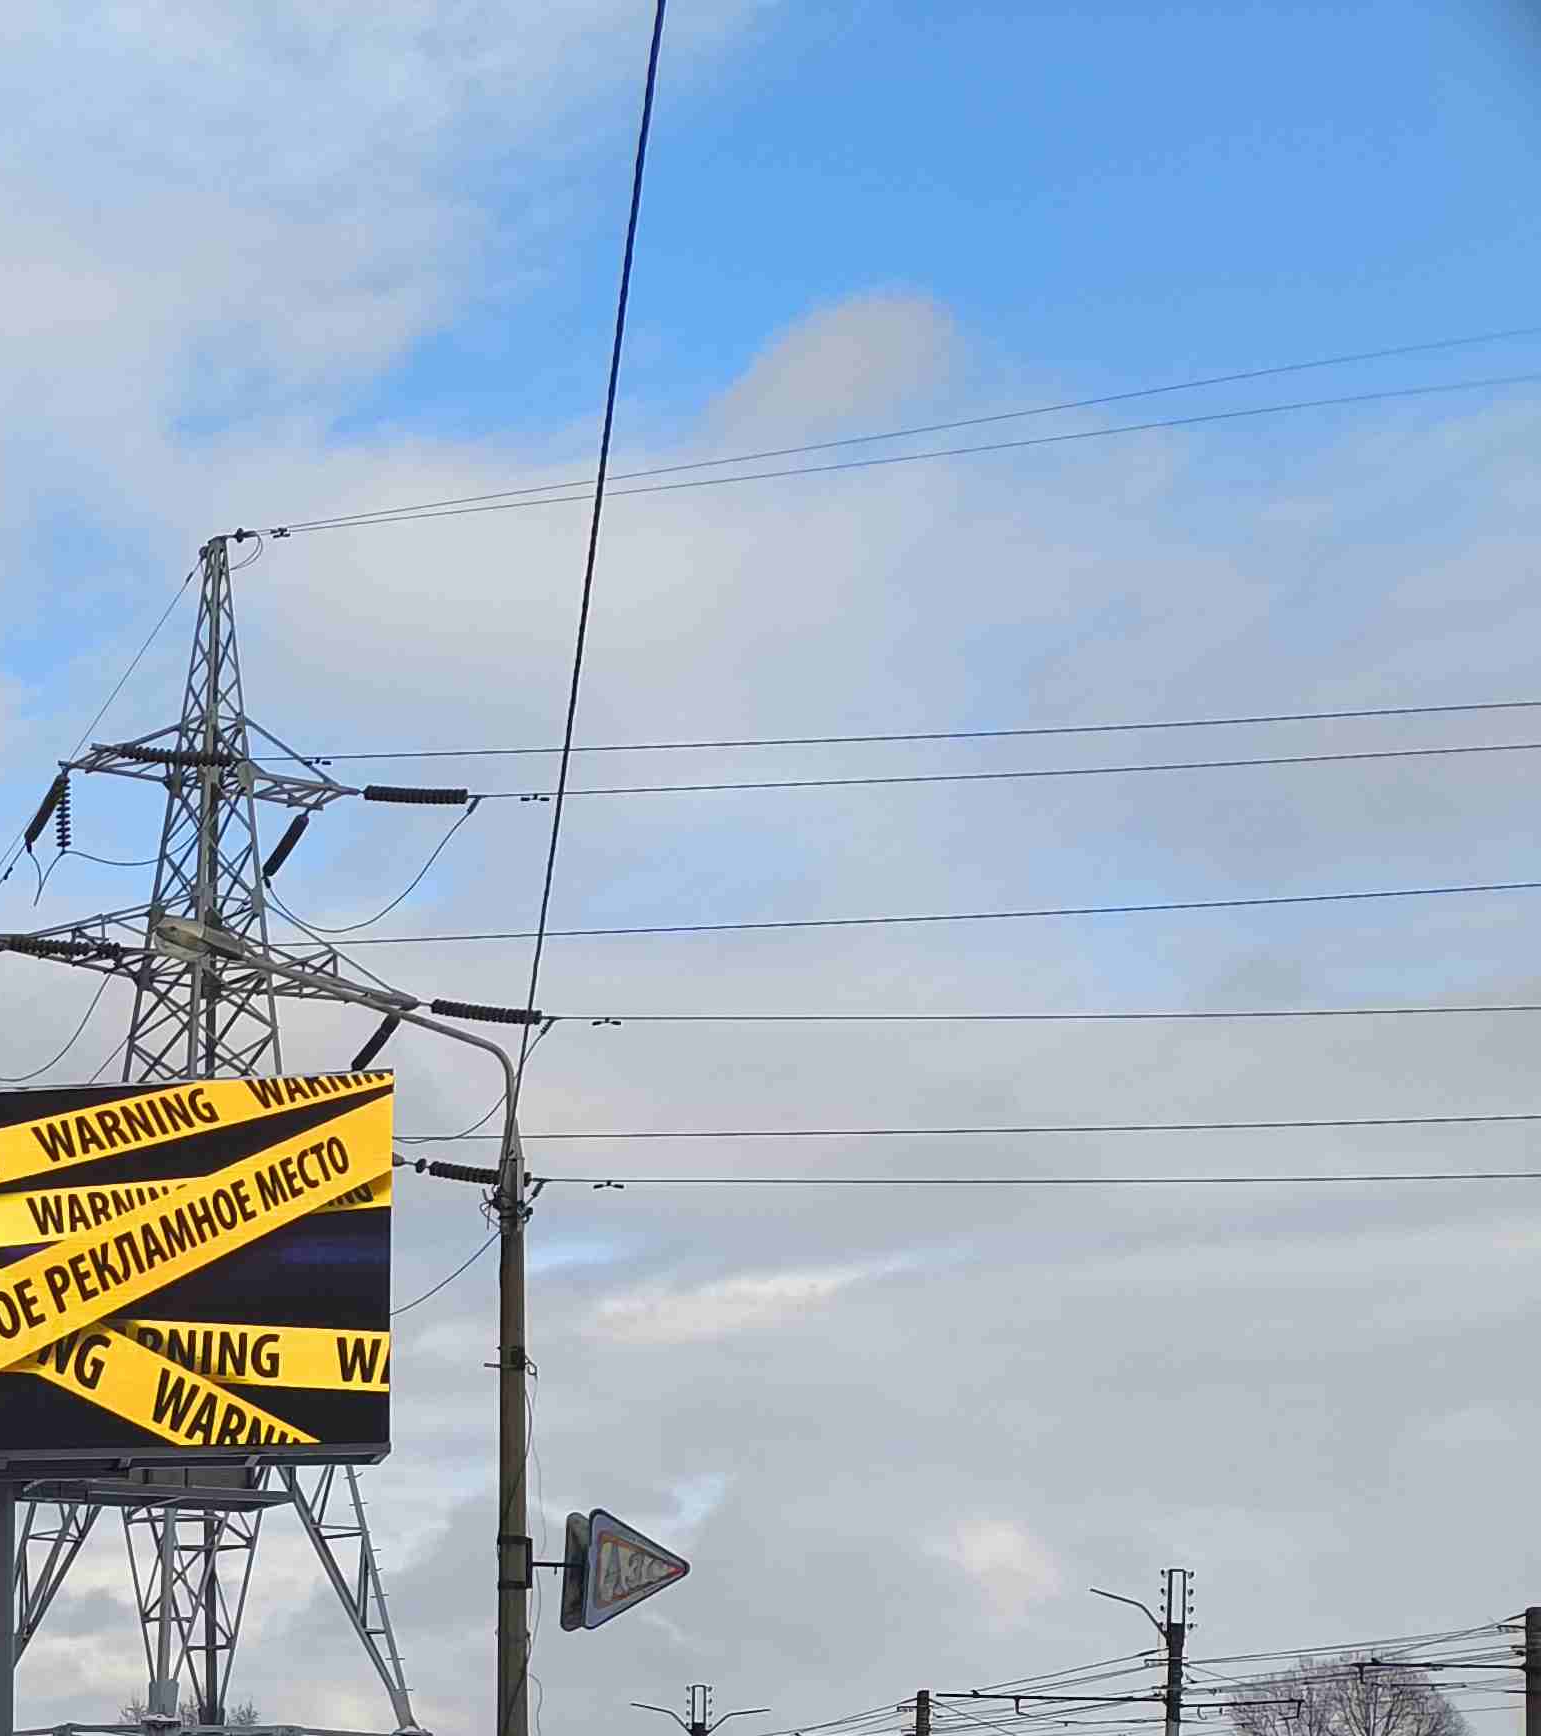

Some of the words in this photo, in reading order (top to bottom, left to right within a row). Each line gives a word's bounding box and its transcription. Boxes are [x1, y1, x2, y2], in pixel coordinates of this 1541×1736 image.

[31, 1087, 220, 1162] WARNING
[44, 1179, 257, 1314] РЕКЛАМНОЕ
[254, 1136, 350, 1212] МЕСТО
